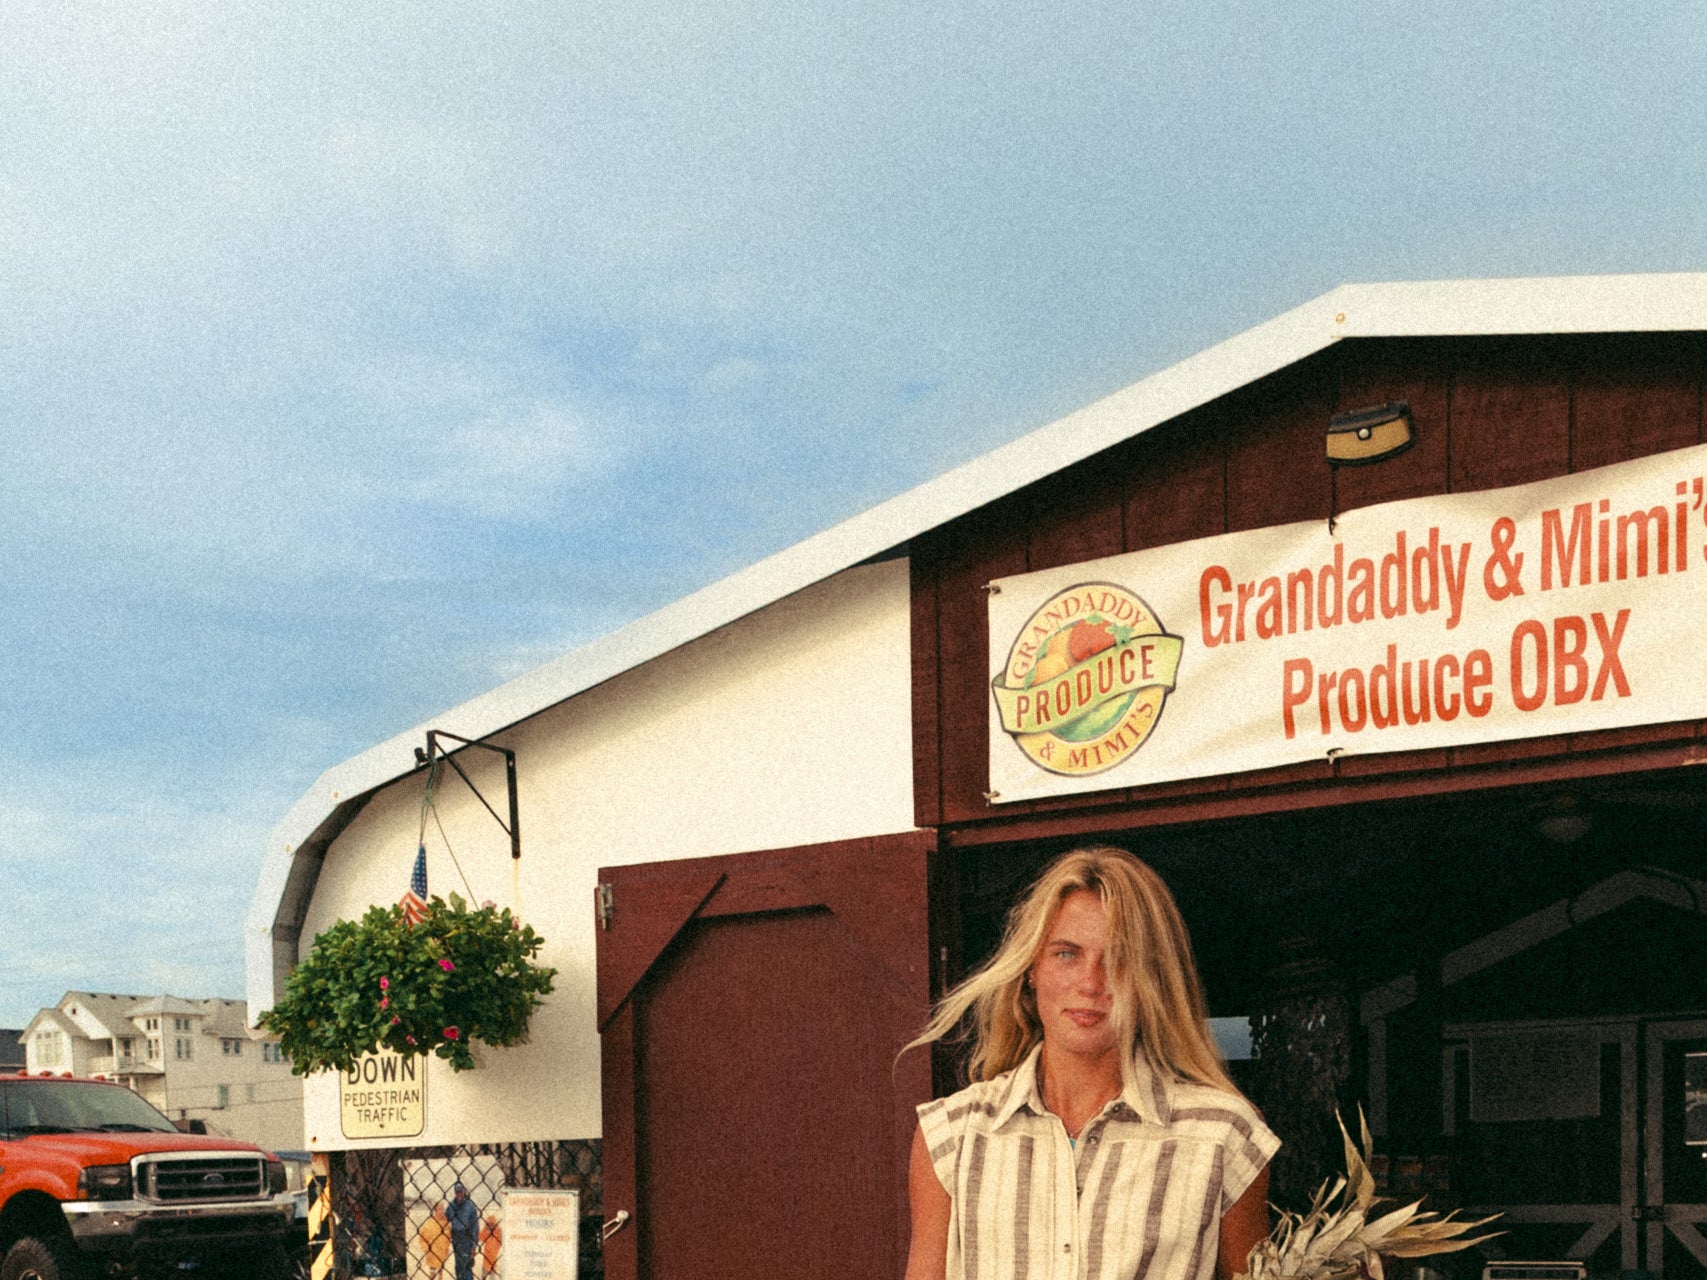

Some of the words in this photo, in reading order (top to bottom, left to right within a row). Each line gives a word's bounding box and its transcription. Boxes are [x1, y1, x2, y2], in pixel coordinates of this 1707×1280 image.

[1199, 526, 1472, 648] Grandaddy
[1483, 516, 1525, 602] &
[1541, 477, 1707, 592] Mimi'
[1012, 592, 1148, 680] GRANDADDY
[1016, 644, 1155, 728] PRODUCE
[1283, 643, 1493, 740] Produce
[1510, 608, 1632, 712] OBX
[1039, 740, 1056, 761] &
[1066, 701, 1153, 768] MIMI'S
[344, 1089, 420, 1107] PEDESTRIAN
[348, 1055, 415, 1085] DOWN
[357, 1107, 407, 1122] TRAFFIC
